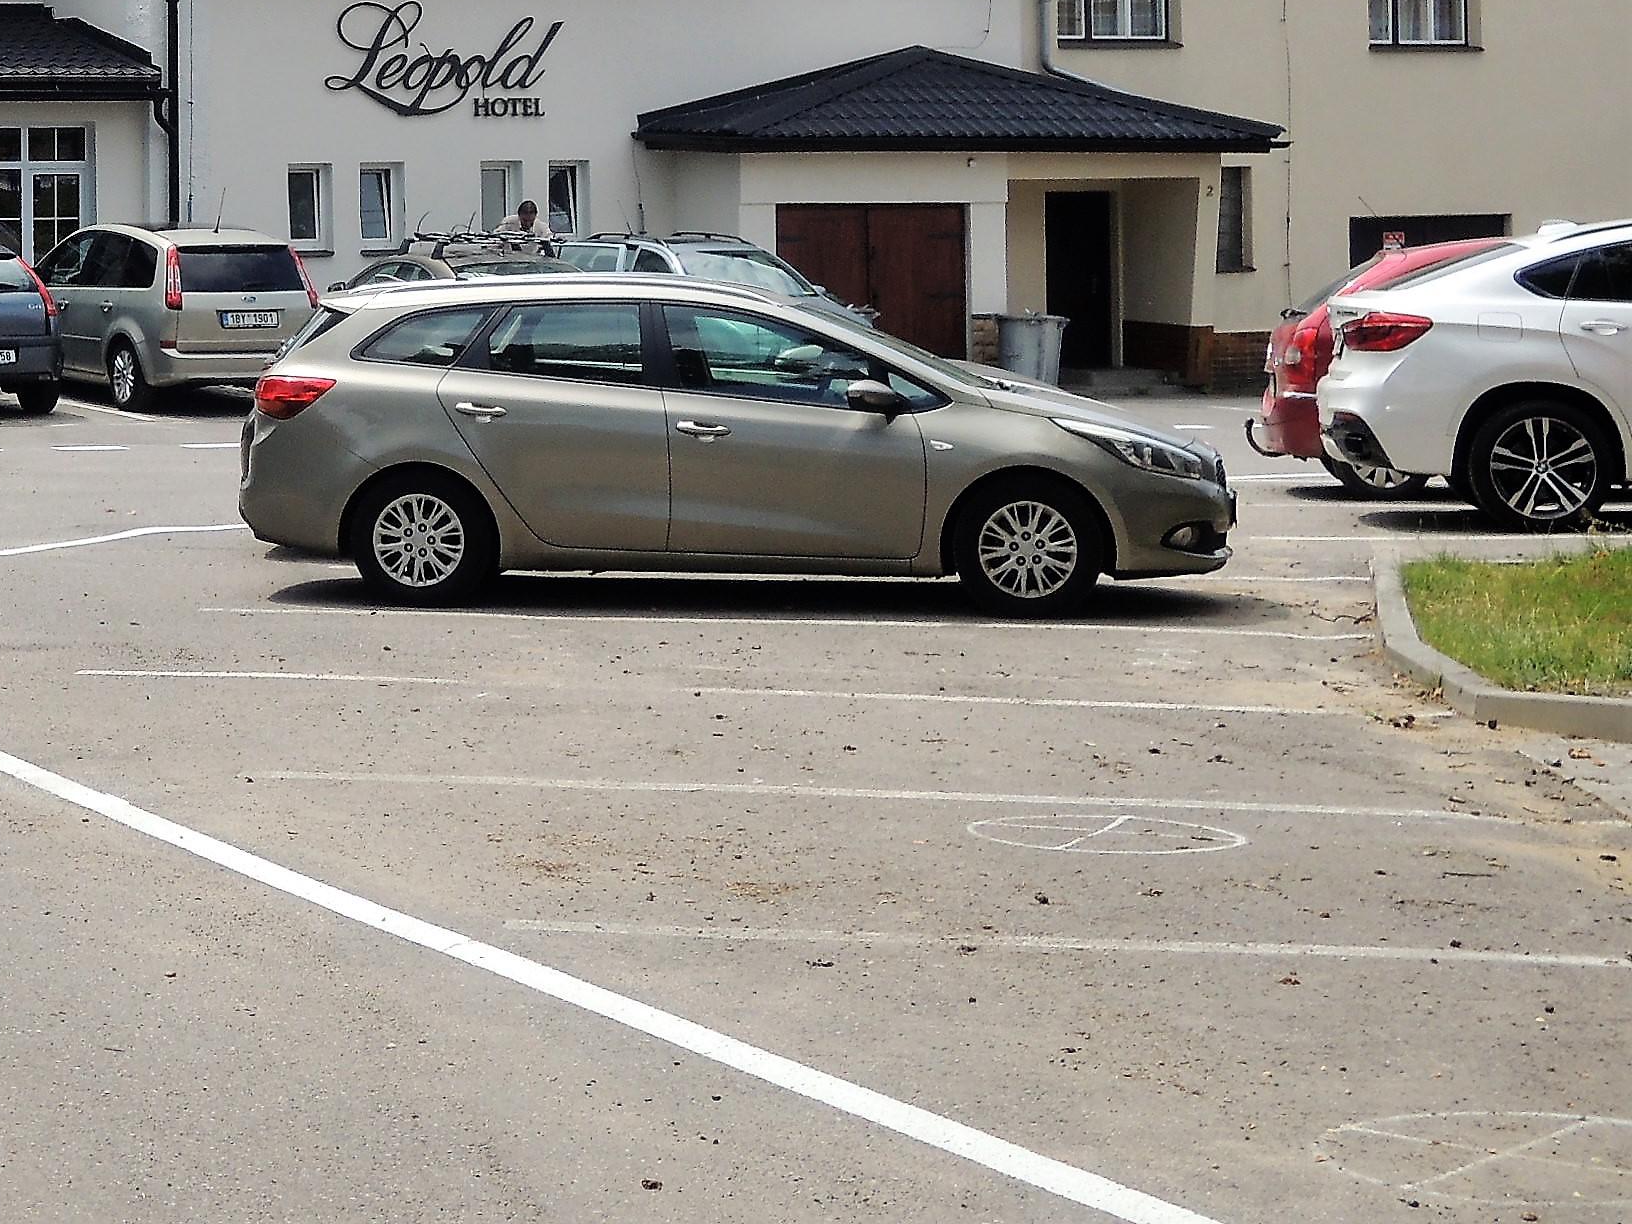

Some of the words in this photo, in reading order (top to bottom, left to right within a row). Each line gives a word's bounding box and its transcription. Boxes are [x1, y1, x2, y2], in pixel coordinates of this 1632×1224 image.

[325, 1, 564, 116] Leopold
[473, 98, 545, 116] HOTEL
[230, 313, 246, 324] 1BY
